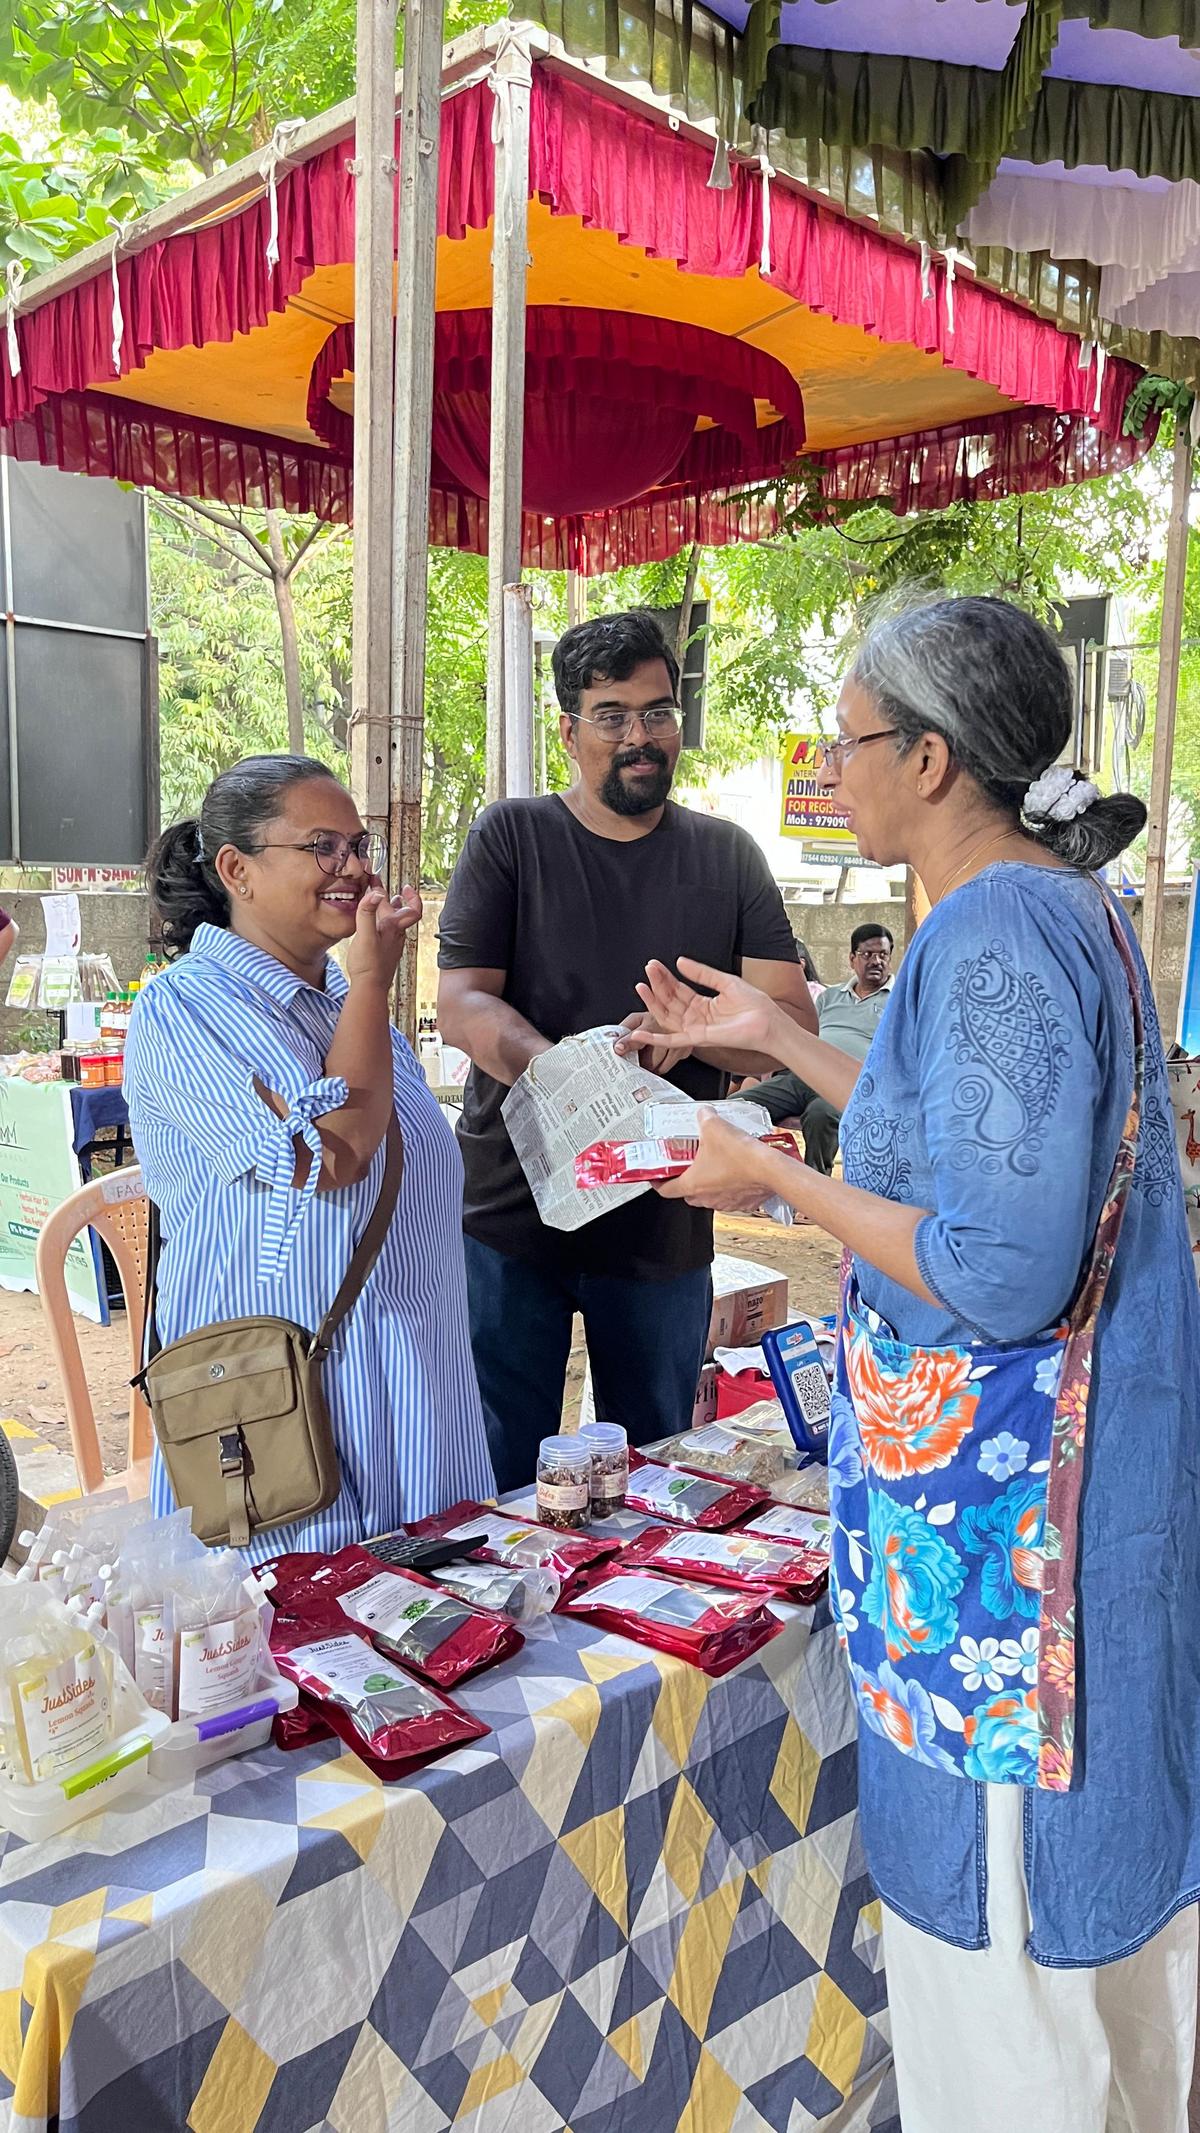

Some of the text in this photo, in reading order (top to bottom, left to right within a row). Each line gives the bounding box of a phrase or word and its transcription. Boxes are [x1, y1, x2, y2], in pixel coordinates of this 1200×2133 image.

[788, 801, 839, 814] FOR REGIS
[786, 814, 807, 825] Mob
[199, 1636, 251, 1662] JustSides
[41, 1676, 96, 1714] JustSides
[48, 1711, 74, 1729] Lemon
